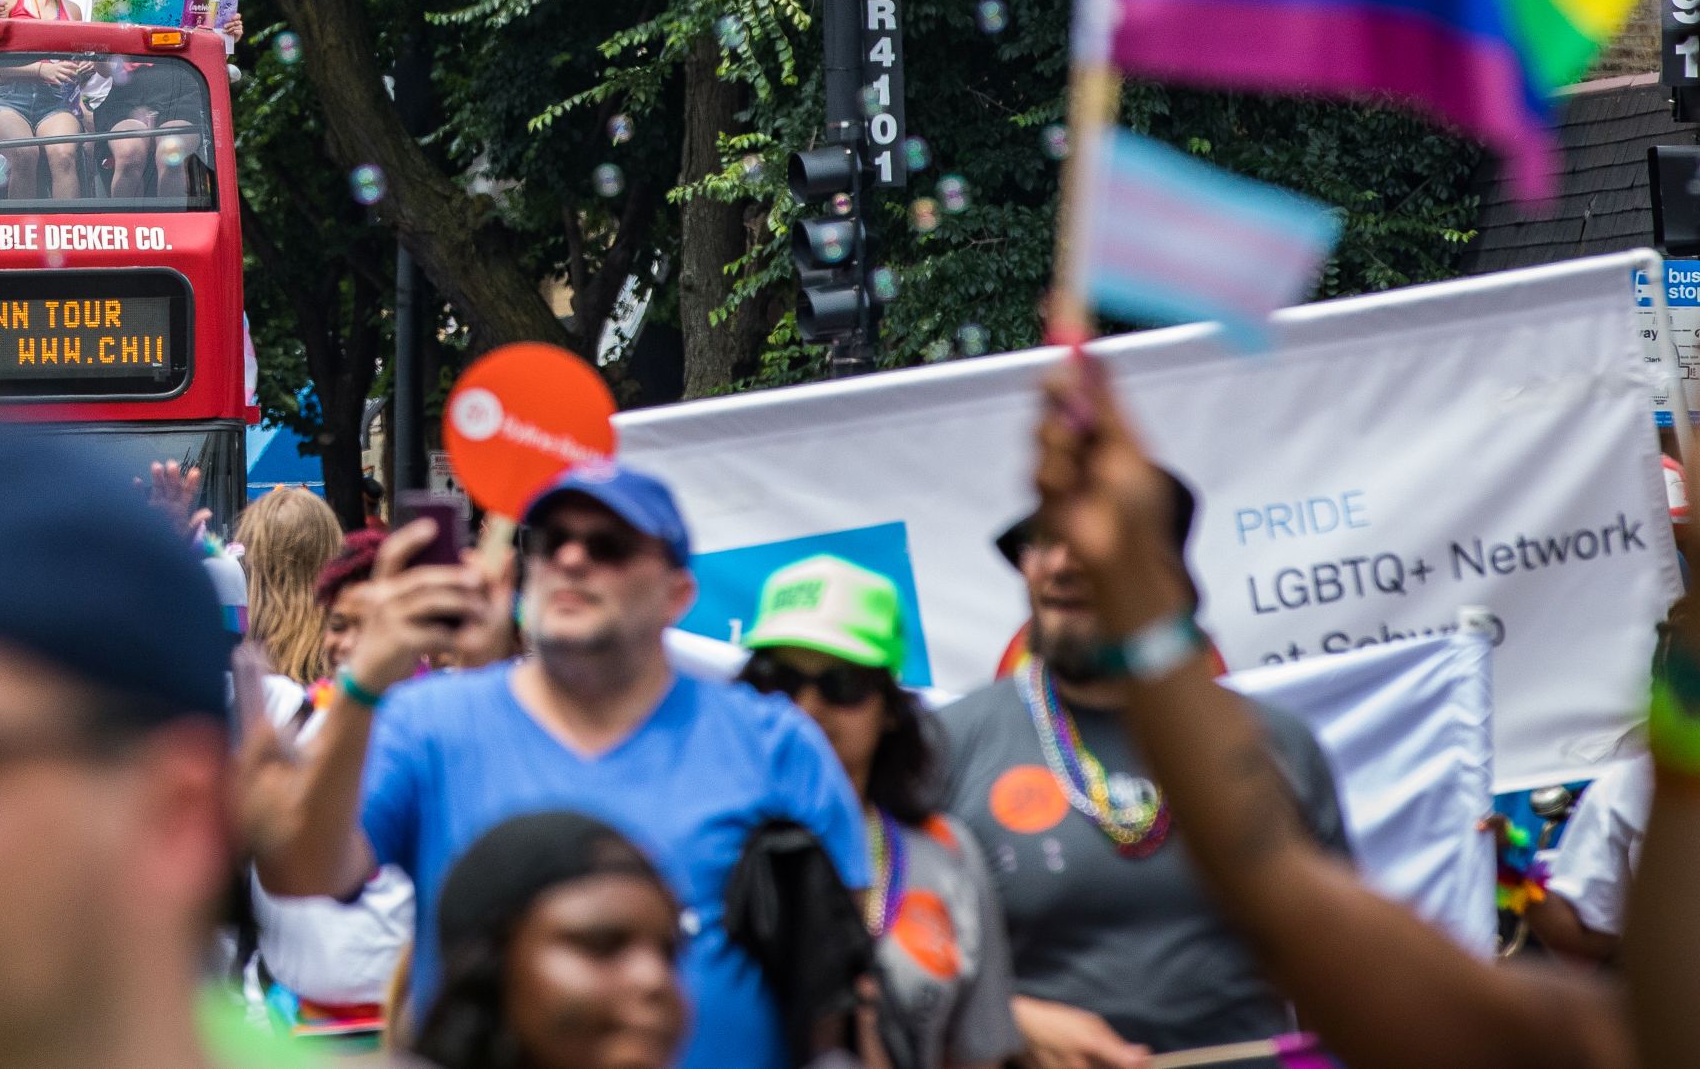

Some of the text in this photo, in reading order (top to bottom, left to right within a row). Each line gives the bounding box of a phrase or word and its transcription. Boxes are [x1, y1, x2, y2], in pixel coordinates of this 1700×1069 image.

[45, 224, 129, 251] DECKER
[135, 226, 173, 250] CO.
[1668, 268, 1700, 284] bus
[1668, 285, 1700, 302] sto
[45, 300, 121, 328] TOUR
[1234, 489, 1372, 546] PRIDE
[1248, 511, 1646, 615] LGBTQ+ Network
